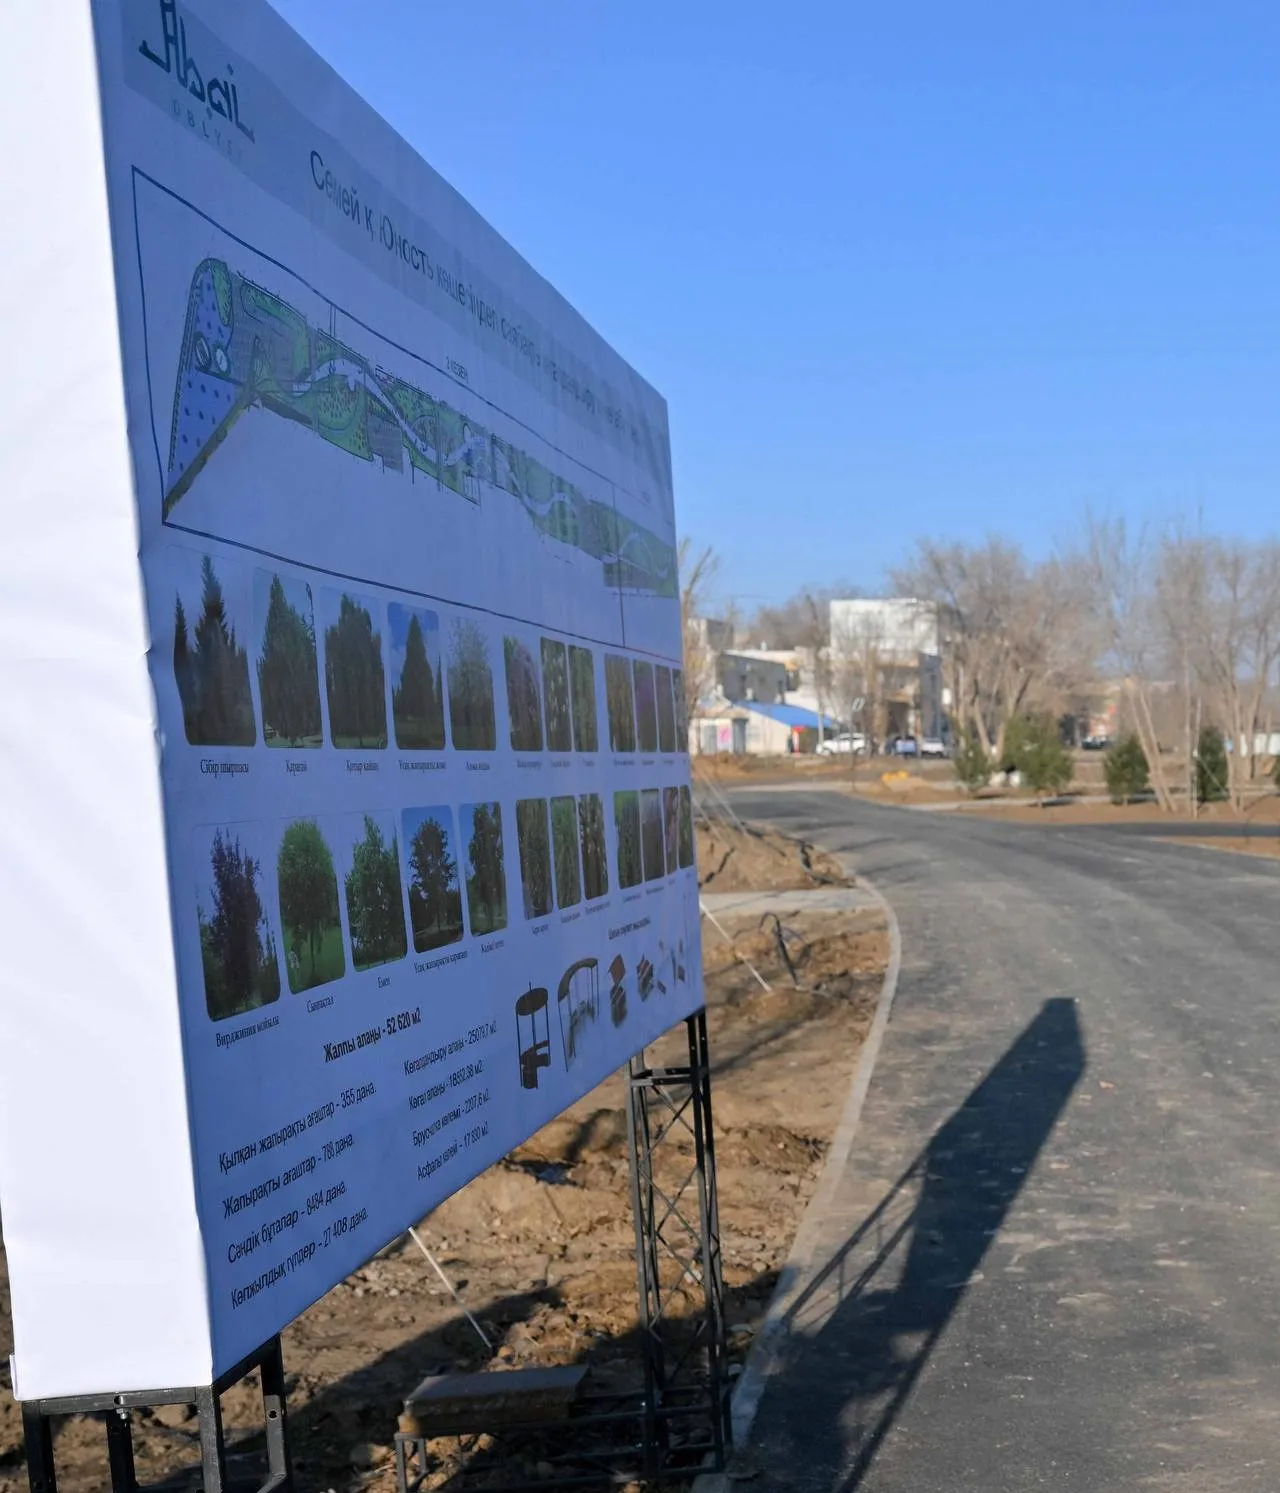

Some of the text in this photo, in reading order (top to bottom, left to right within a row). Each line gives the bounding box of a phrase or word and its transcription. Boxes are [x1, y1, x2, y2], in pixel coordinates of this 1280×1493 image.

[310, 150, 360, 225] Семей
[379, 211, 434, 281] Юность
[324, 1038, 356, 1062] Жалпы
[357, 1026, 381, 1049] алаңы
[387, 1017, 396, 1035] 52
[397, 1012, 410, 1032] 620
[410, 1007, 421, 1026] м2
[219, 1143, 256, 1175] Қылқан
[258, 1118, 306, 1153] жапырақты
[307, 1102, 334, 1127] ағаштар
[341, 1088, 355, 1108] 355
[222, 1176, 280, 1219] Жапырақты
[283, 1156, 316, 1186] ағаштар
[228, 1232, 260, 1263] Сәндік
[231, 1262, 286, 1309] Көпжылдық
